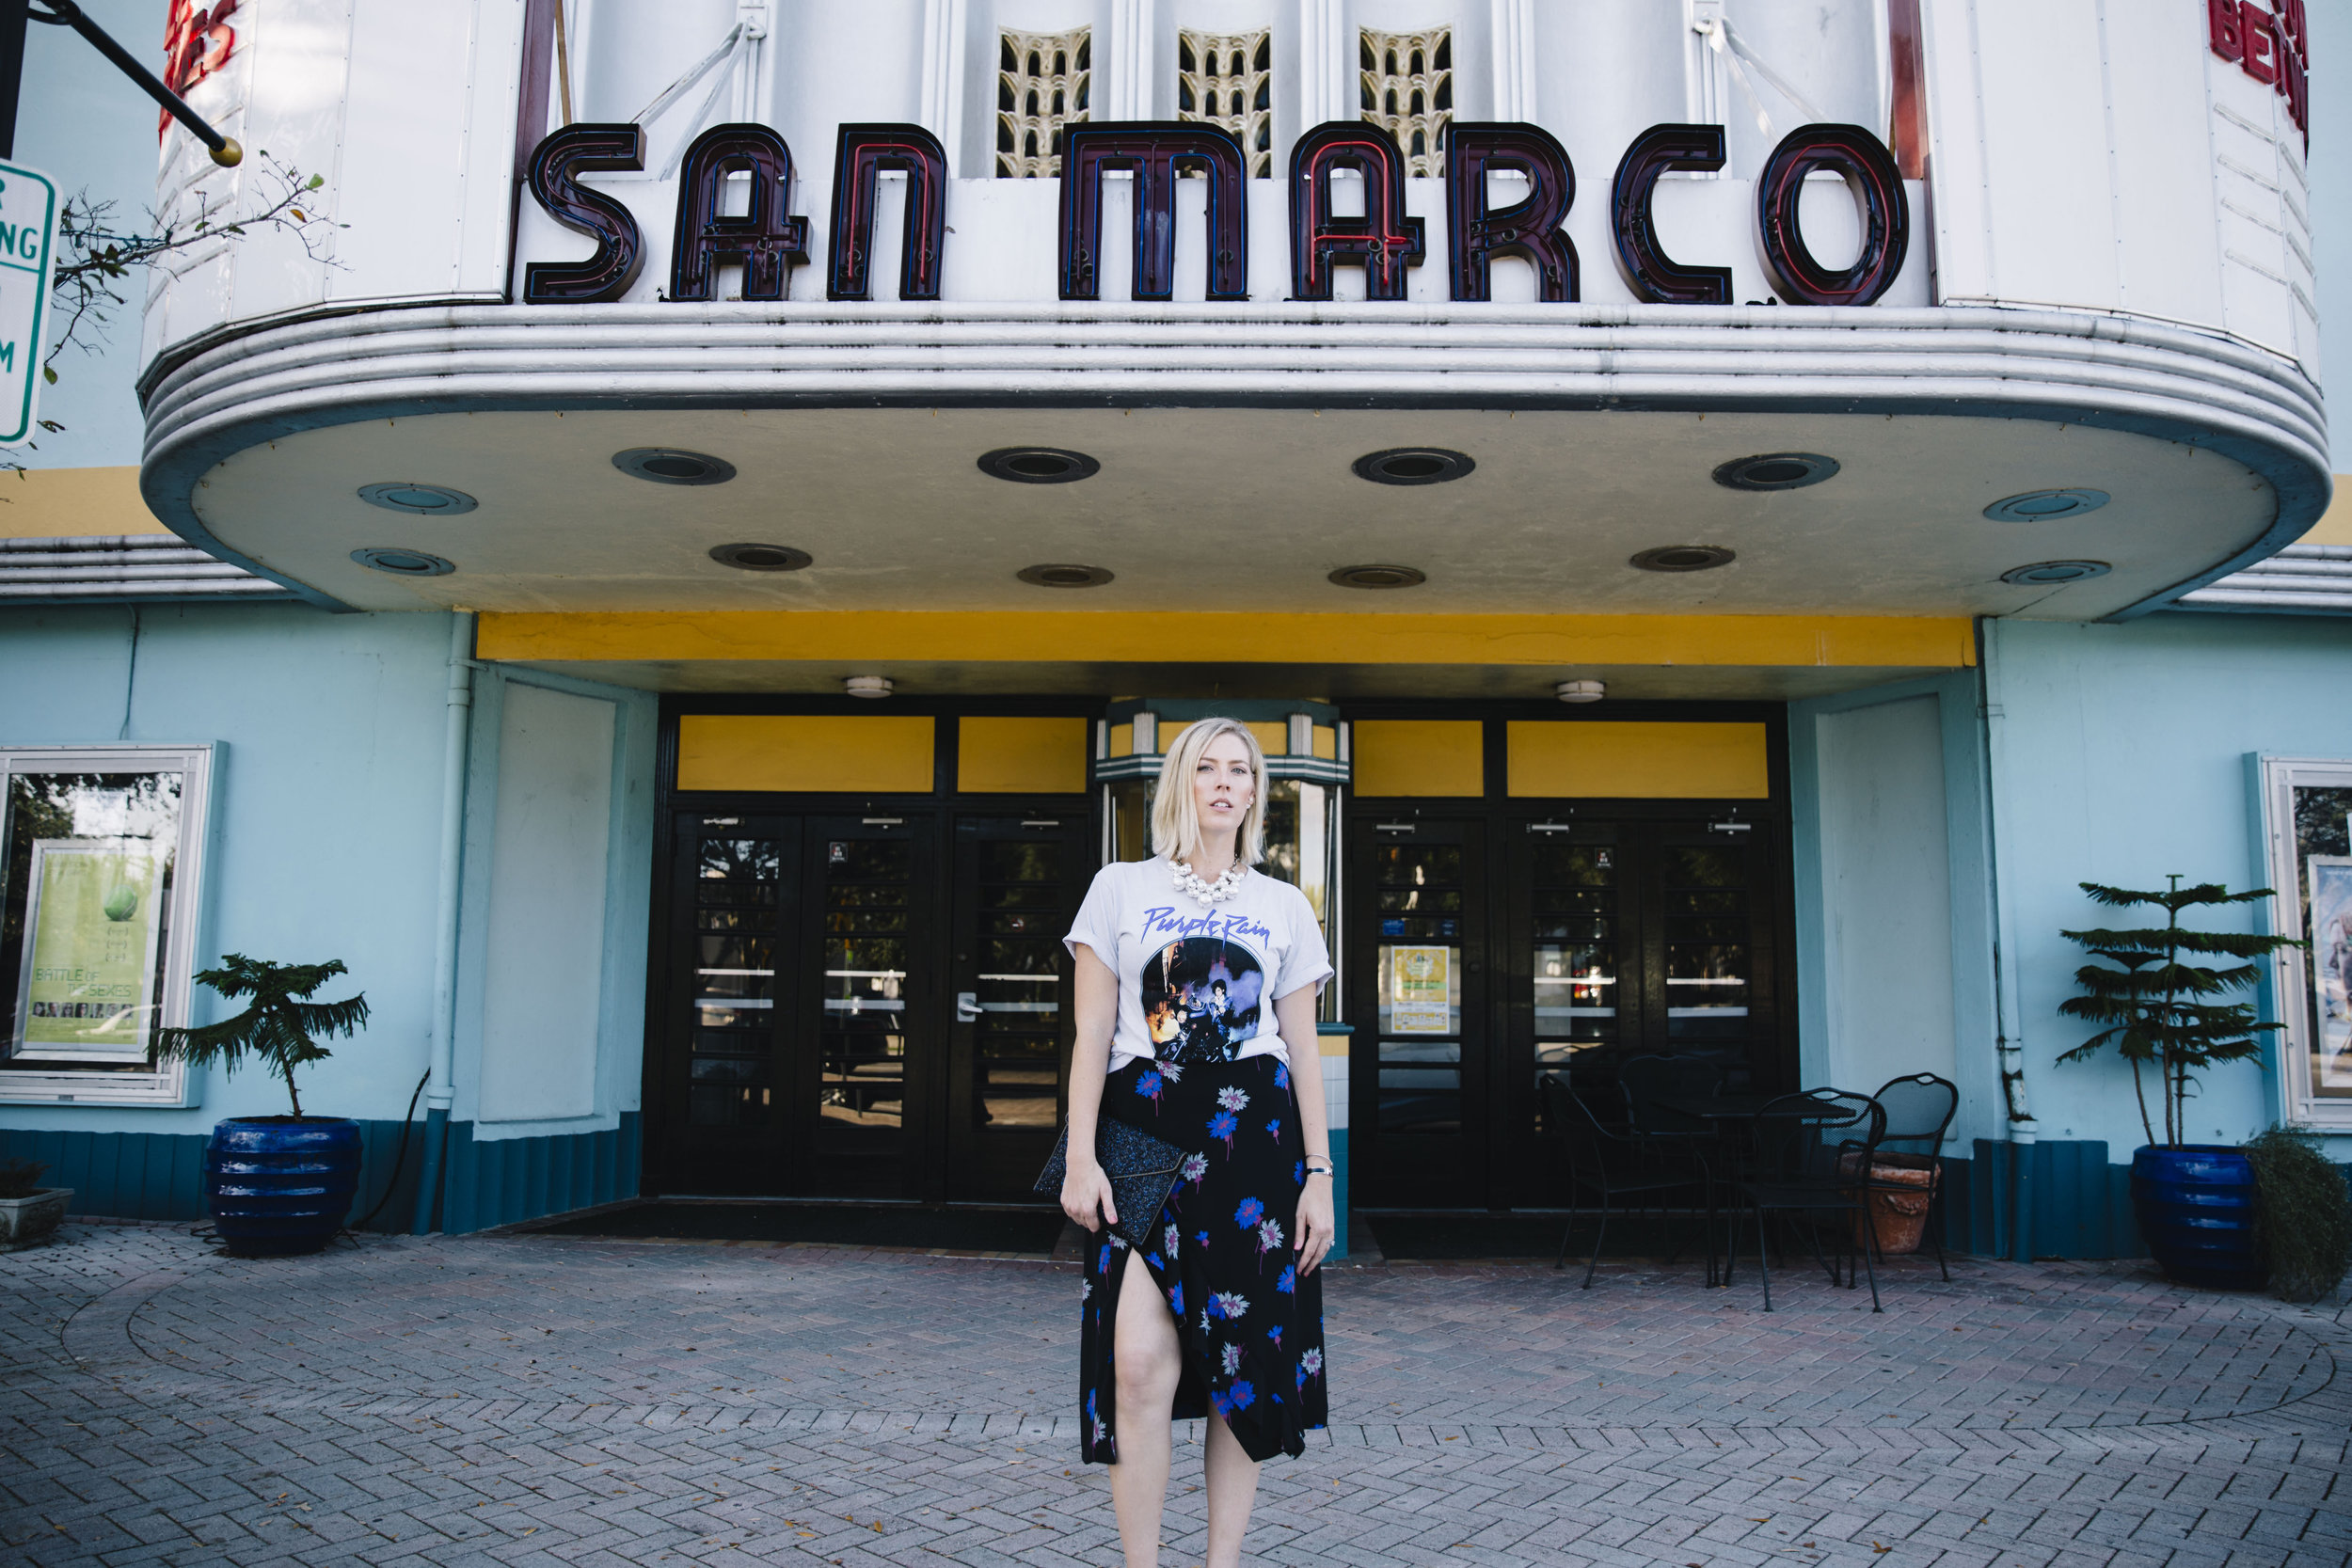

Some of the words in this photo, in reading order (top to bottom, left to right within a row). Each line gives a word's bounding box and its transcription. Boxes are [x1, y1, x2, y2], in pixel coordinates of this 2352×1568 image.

[523, 122, 951, 304] SAN
[1059, 120, 1909, 306] MARCO
[1141, 906, 1222, 945] Purple
[1221, 913, 1270, 955] Rain
[35, 967, 83, 982] BATTLE
[87, 984, 132, 997] SEXES
